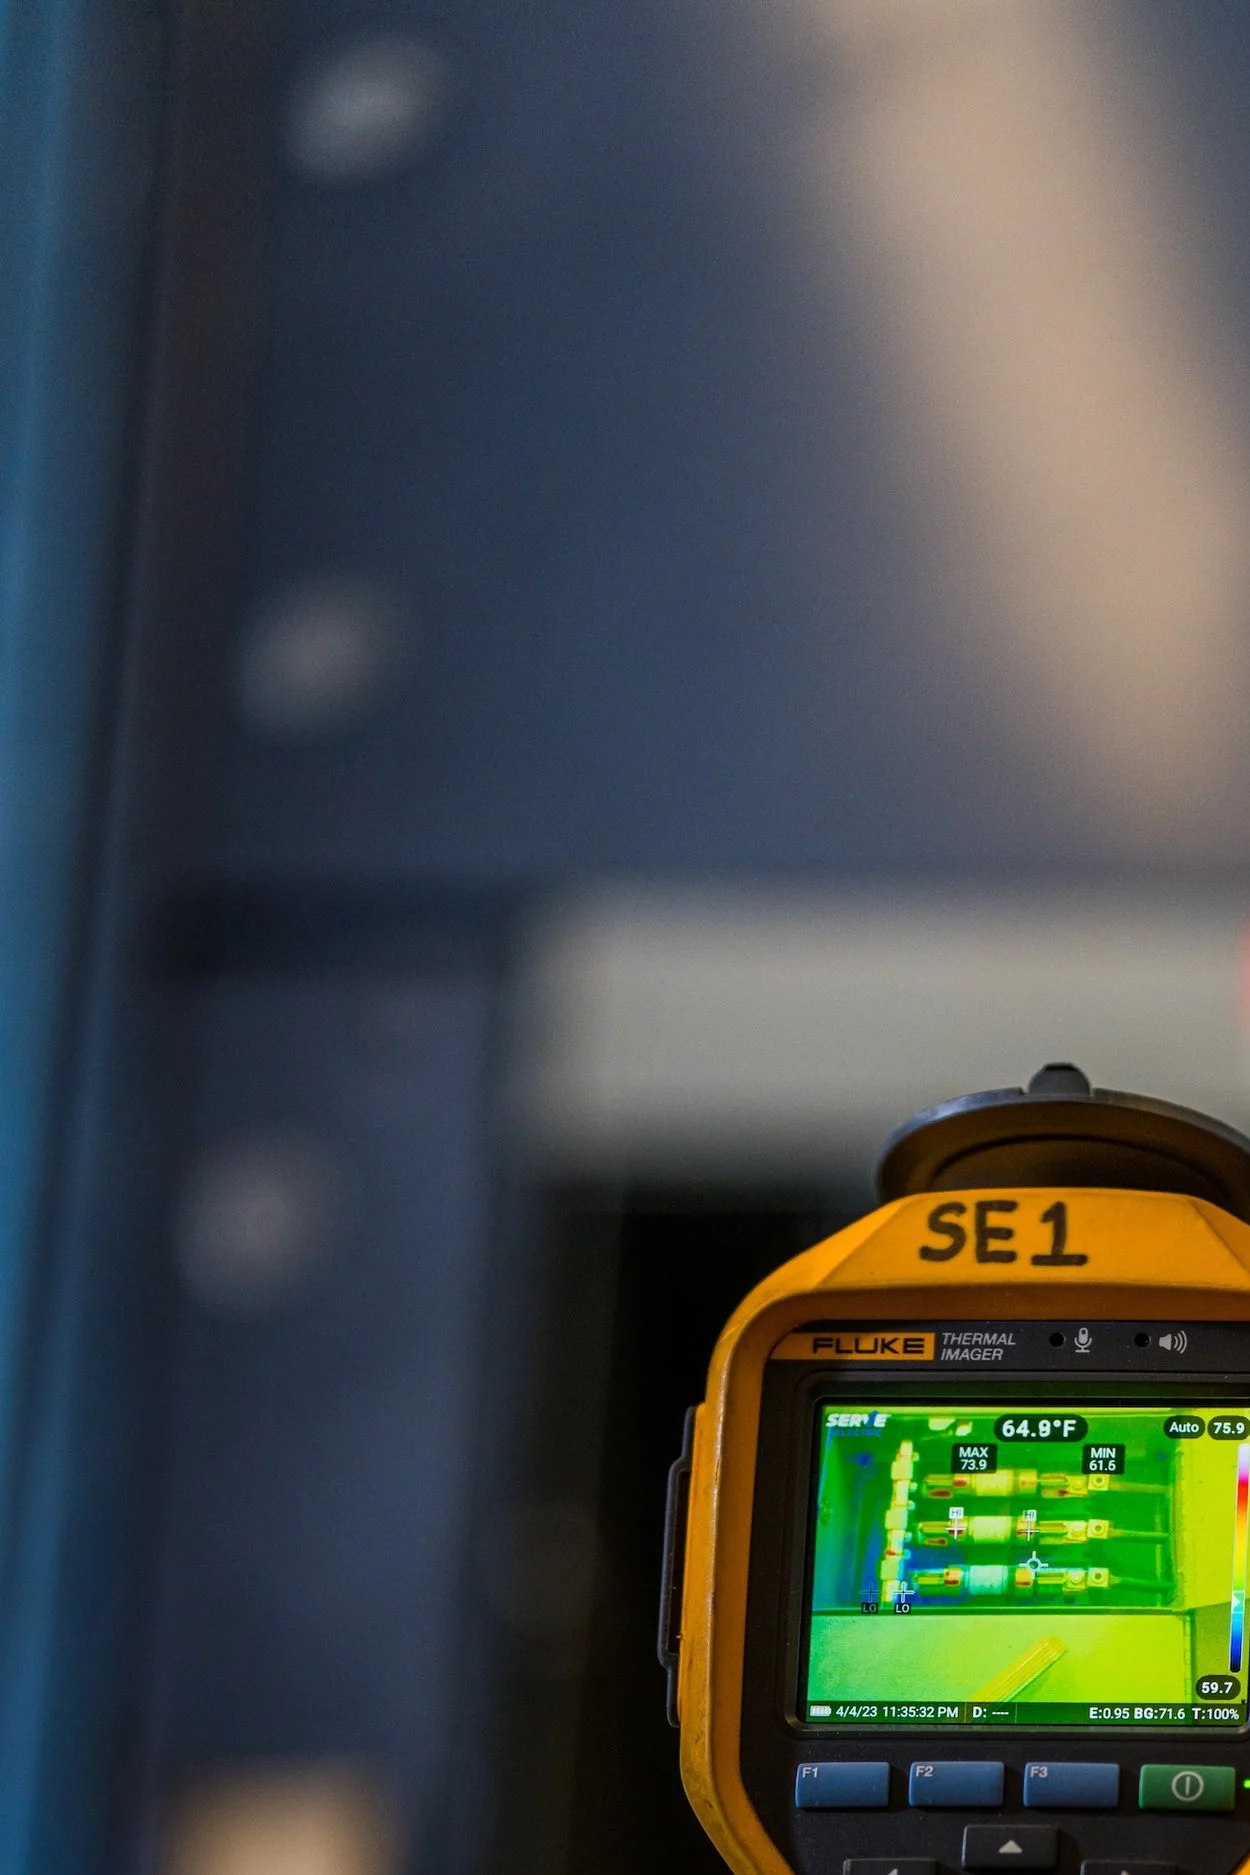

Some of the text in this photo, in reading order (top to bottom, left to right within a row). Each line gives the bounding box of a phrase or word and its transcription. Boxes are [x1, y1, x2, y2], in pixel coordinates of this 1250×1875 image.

[941, 1332, 1017, 1346] THERMAL
[812, 1337, 926, 1355] FLUKE
[940, 1347, 1004, 1361] IMAGER
[1169, 1421, 1199, 1433] Auto
[1213, 1422, 1245, 1434] 75.9
[958, 1447, 989, 1458] MAX
[1090, 1447, 1116, 1458] MIN
[960, 1459, 988, 1470] 73.9
[862, 1603, 877, 1613] LO
[895, 1603, 910, 1613] LO
[1201, 1681, 1233, 1694] 59.7
[835, 1705, 959, 1718] 4/4/23 11:35:32 PM
[972, 1706, 987, 1718] D:
[1089, 1708, 1240, 1720] E:0.95 BG:71.6 T:100%
[802, 1767, 819, 1778] F1
[915, 1766, 933, 1777] F2
[1030, 1766, 1048, 1778] F3
